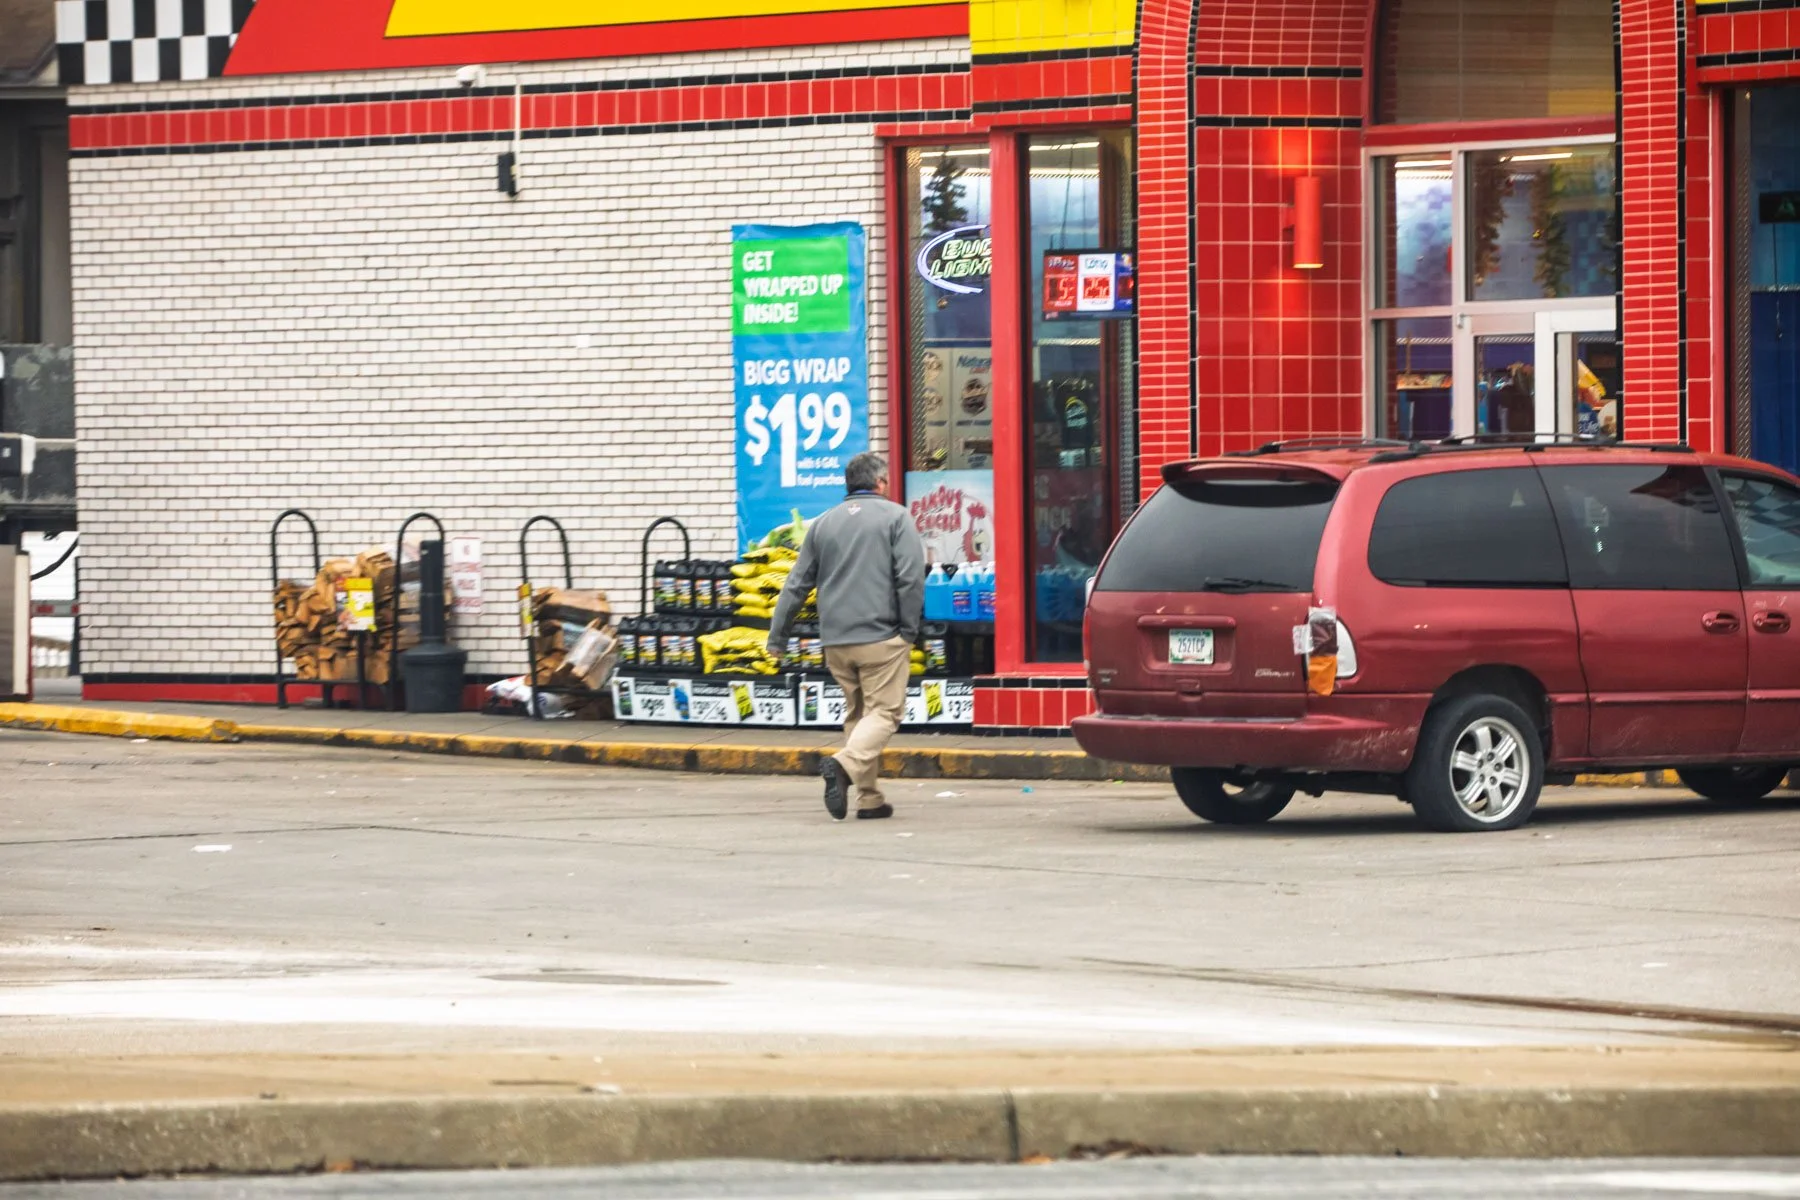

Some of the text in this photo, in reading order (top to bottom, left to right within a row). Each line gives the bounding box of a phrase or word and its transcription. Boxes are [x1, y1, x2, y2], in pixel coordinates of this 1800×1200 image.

[742, 250, 774, 272] GET
[743, 274, 844, 298] WRAPPED UP
[743, 302, 799, 324] INSIDE!
[744, 357, 851, 386] BIGG WRAP
